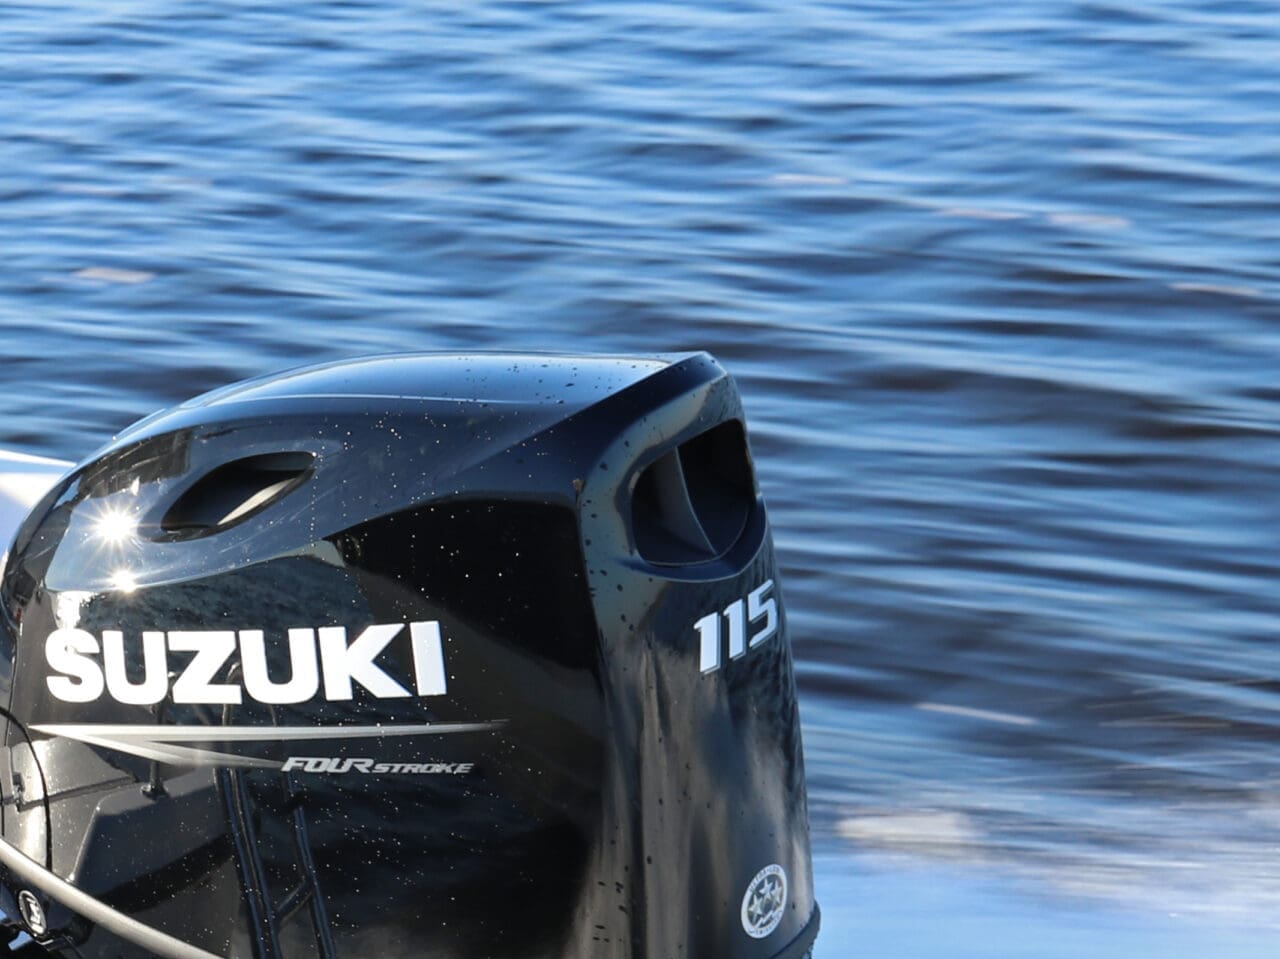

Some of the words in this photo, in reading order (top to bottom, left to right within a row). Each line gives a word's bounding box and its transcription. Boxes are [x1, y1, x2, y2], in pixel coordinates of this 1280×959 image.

[45, 621, 448, 705] SUZUKI
[693, 579, 778, 674] 115
[281, 756, 374, 774] FOUR
[372, 762, 475, 774] STROKE
